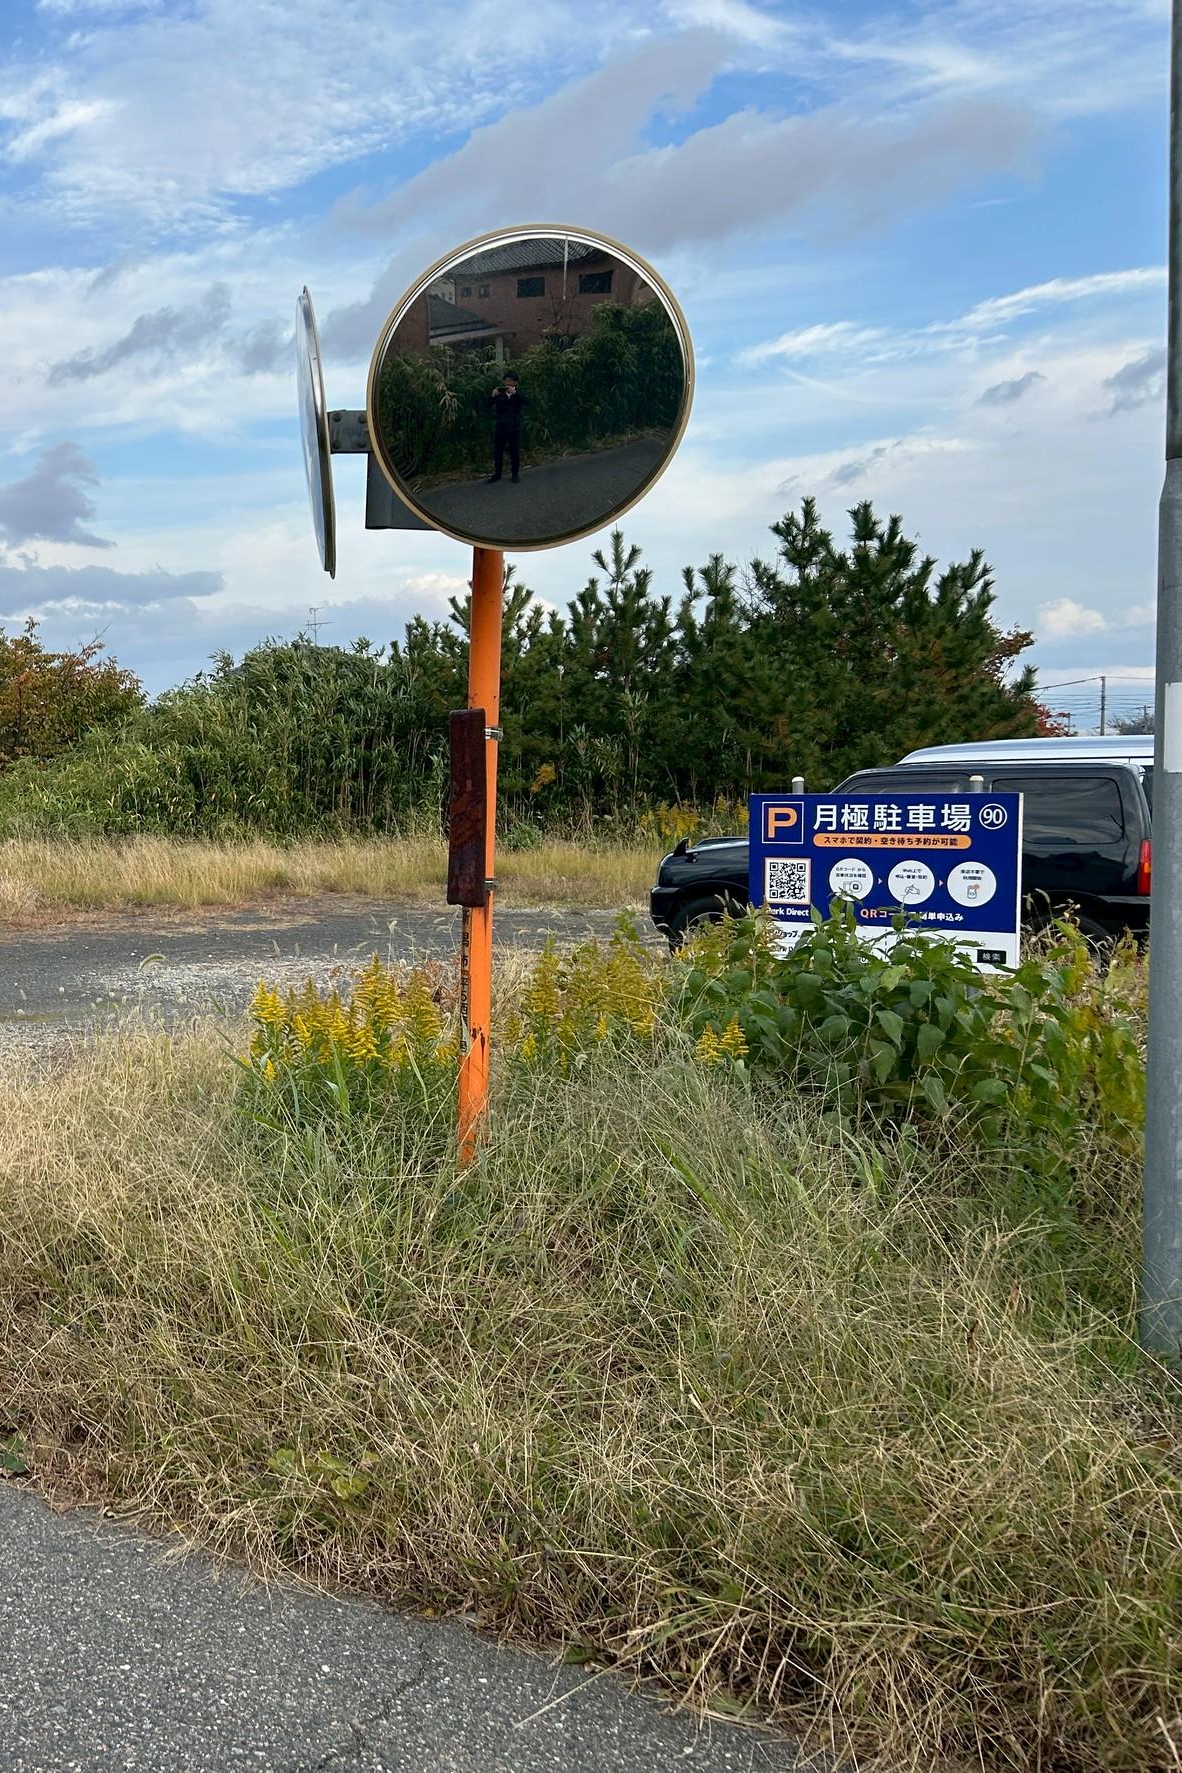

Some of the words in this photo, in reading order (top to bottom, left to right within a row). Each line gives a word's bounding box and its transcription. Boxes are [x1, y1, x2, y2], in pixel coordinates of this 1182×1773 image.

[768, 807, 798, 838] P
[813, 803, 972, 832] 月極駐車場
[983, 808, 1003, 824] 90
[823, 836, 959, 847] スマホで契約・空き待ち予約が可能
[786, 907, 809, 917] Direct
